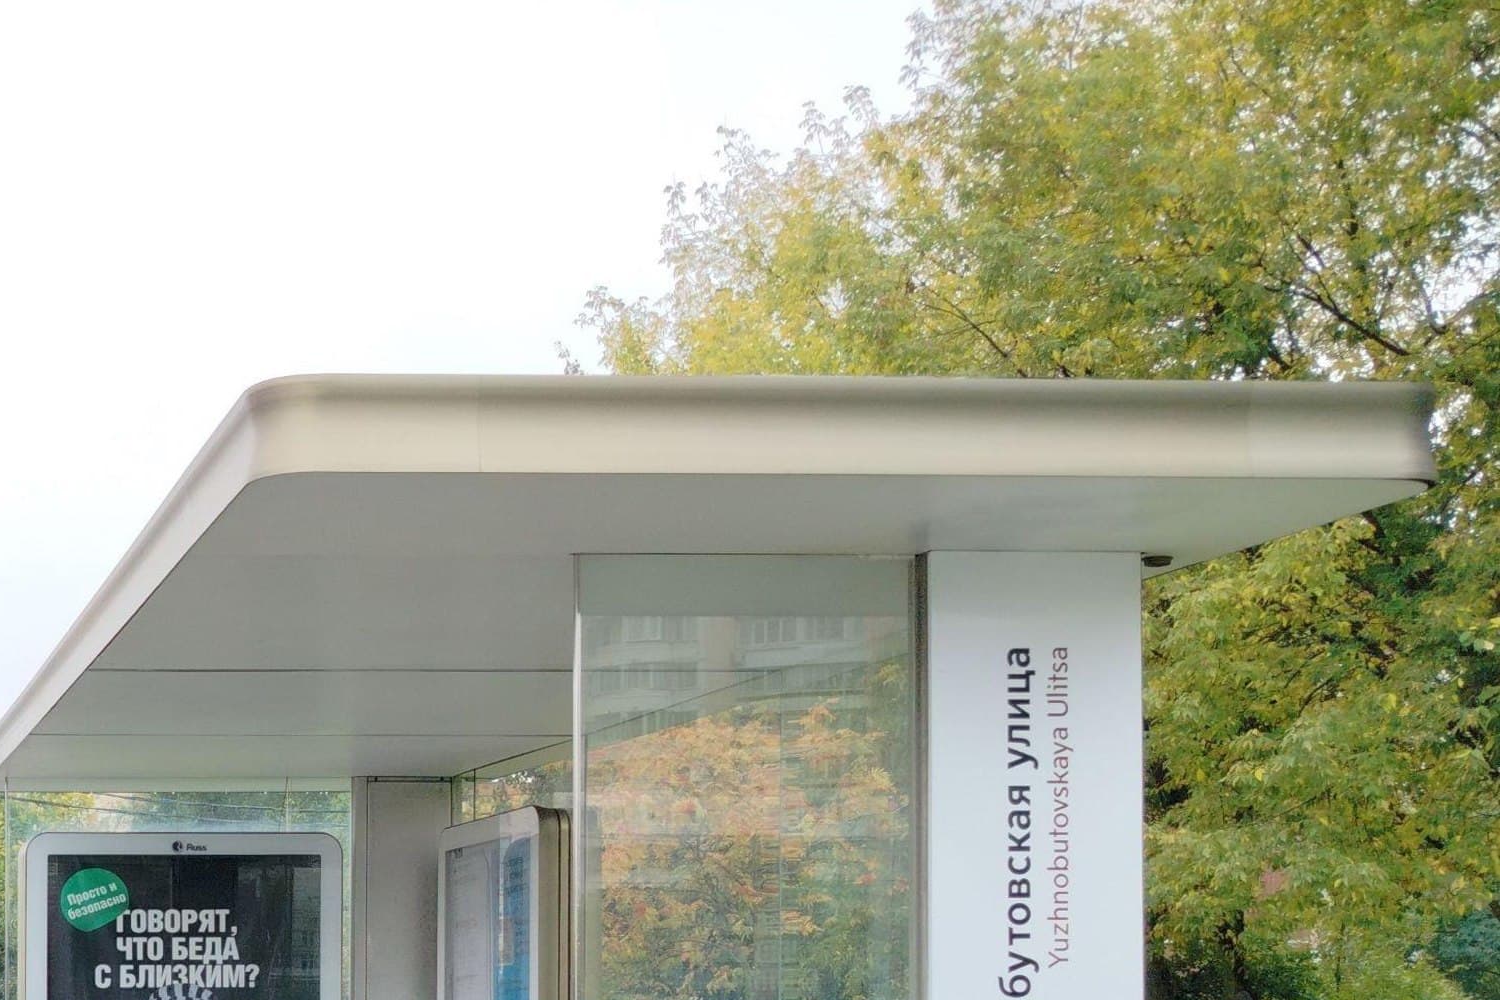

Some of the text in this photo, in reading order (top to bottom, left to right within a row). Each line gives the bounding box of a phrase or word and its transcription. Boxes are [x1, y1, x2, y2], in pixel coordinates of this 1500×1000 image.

[1006, 646, 1039, 771] улица
[1046, 646, 1074, 968] Yuzhnobutovskaya Ulitsa
[67, 882, 118, 906] Просто и
[67, 893, 127, 920] безопасно
[116, 908, 238, 936] ГОВОРЯТ,
[116, 936, 240, 965] ЧТО БЕДА
[94, 964, 260, 989] С БЛИЗКИМ?
